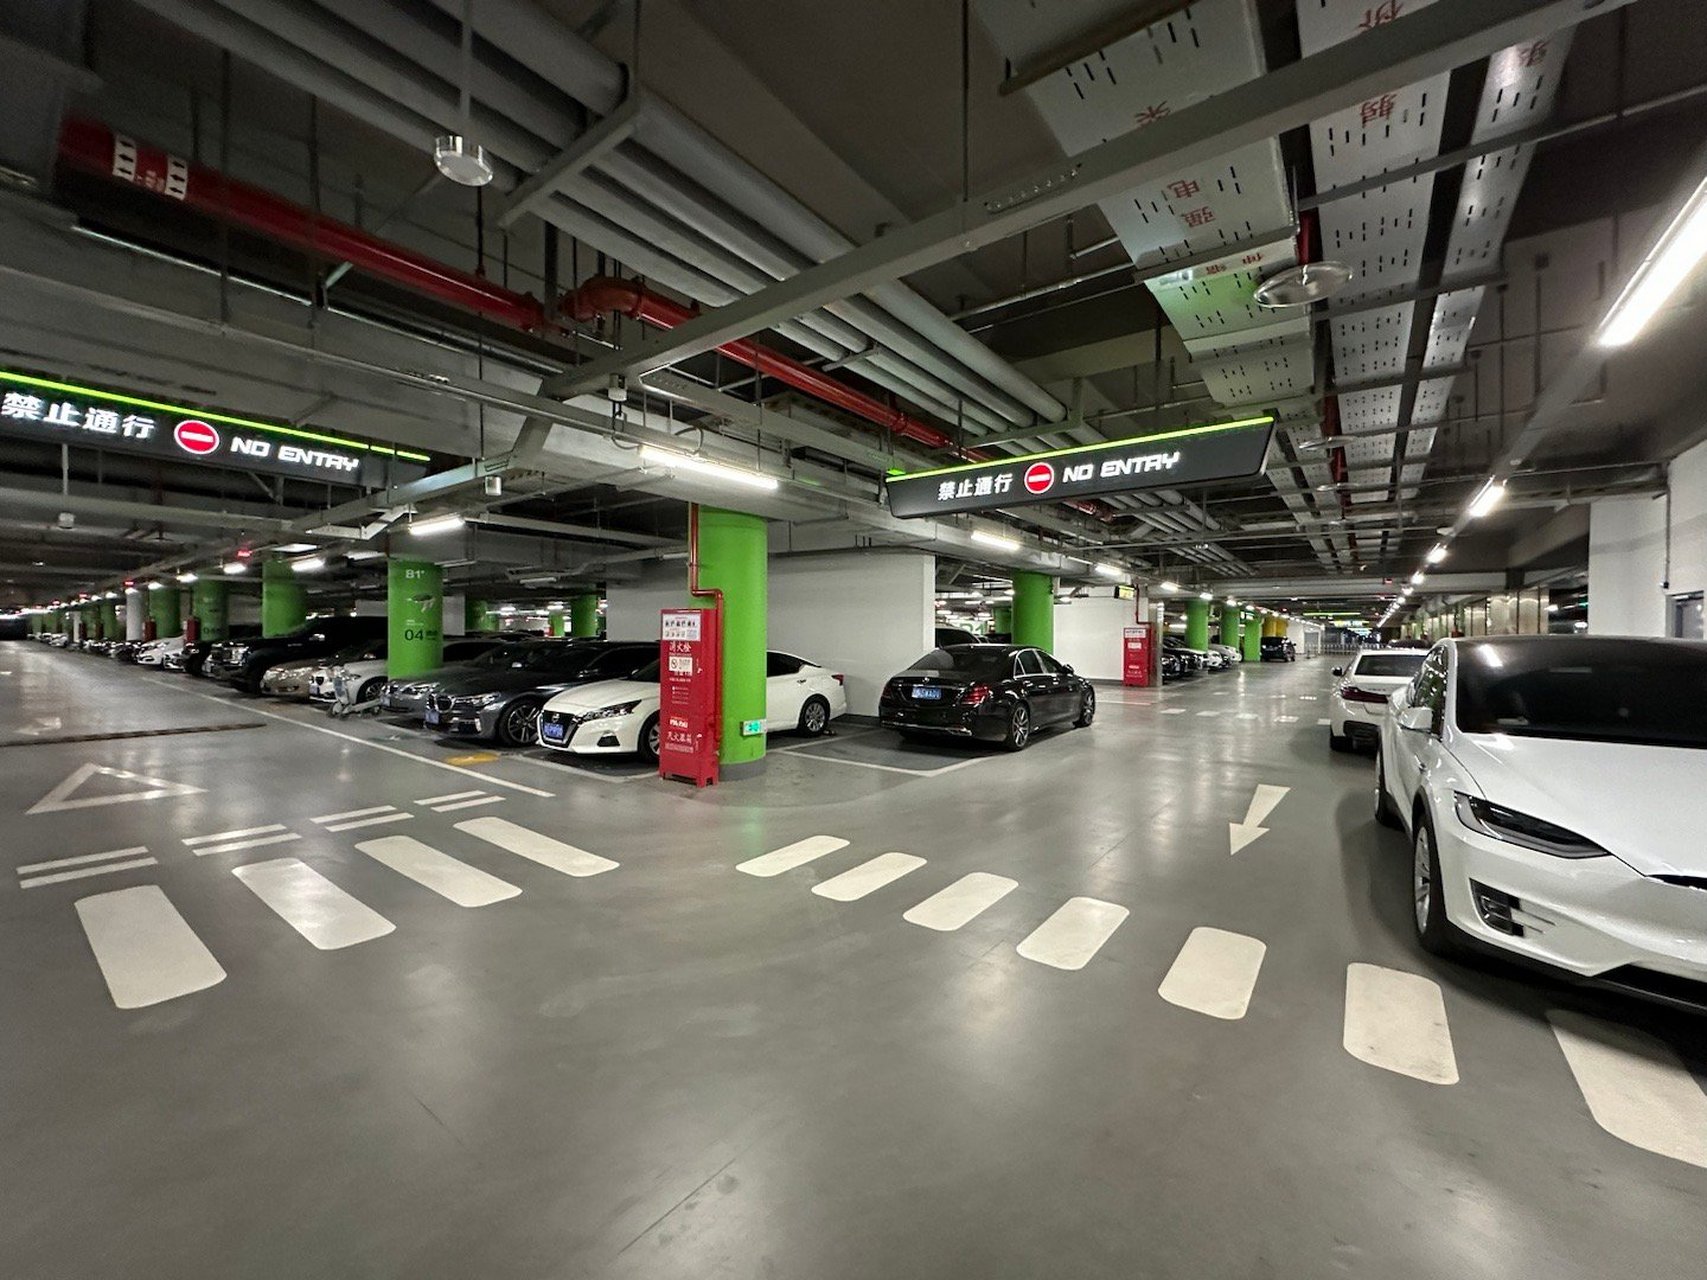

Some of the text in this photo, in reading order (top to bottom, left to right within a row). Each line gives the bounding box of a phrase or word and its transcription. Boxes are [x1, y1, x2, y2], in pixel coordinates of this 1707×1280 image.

[1166, 179, 1217, 229] 强电
[0, 391, 156, 440] 禁止通行
[230, 436, 360, 472] NO ENTRY
[1062, 451, 1182, 484] NO ENTRY
[936, 472, 1014, 501] 禁止通行
[404, 629, 423, 641] 04
